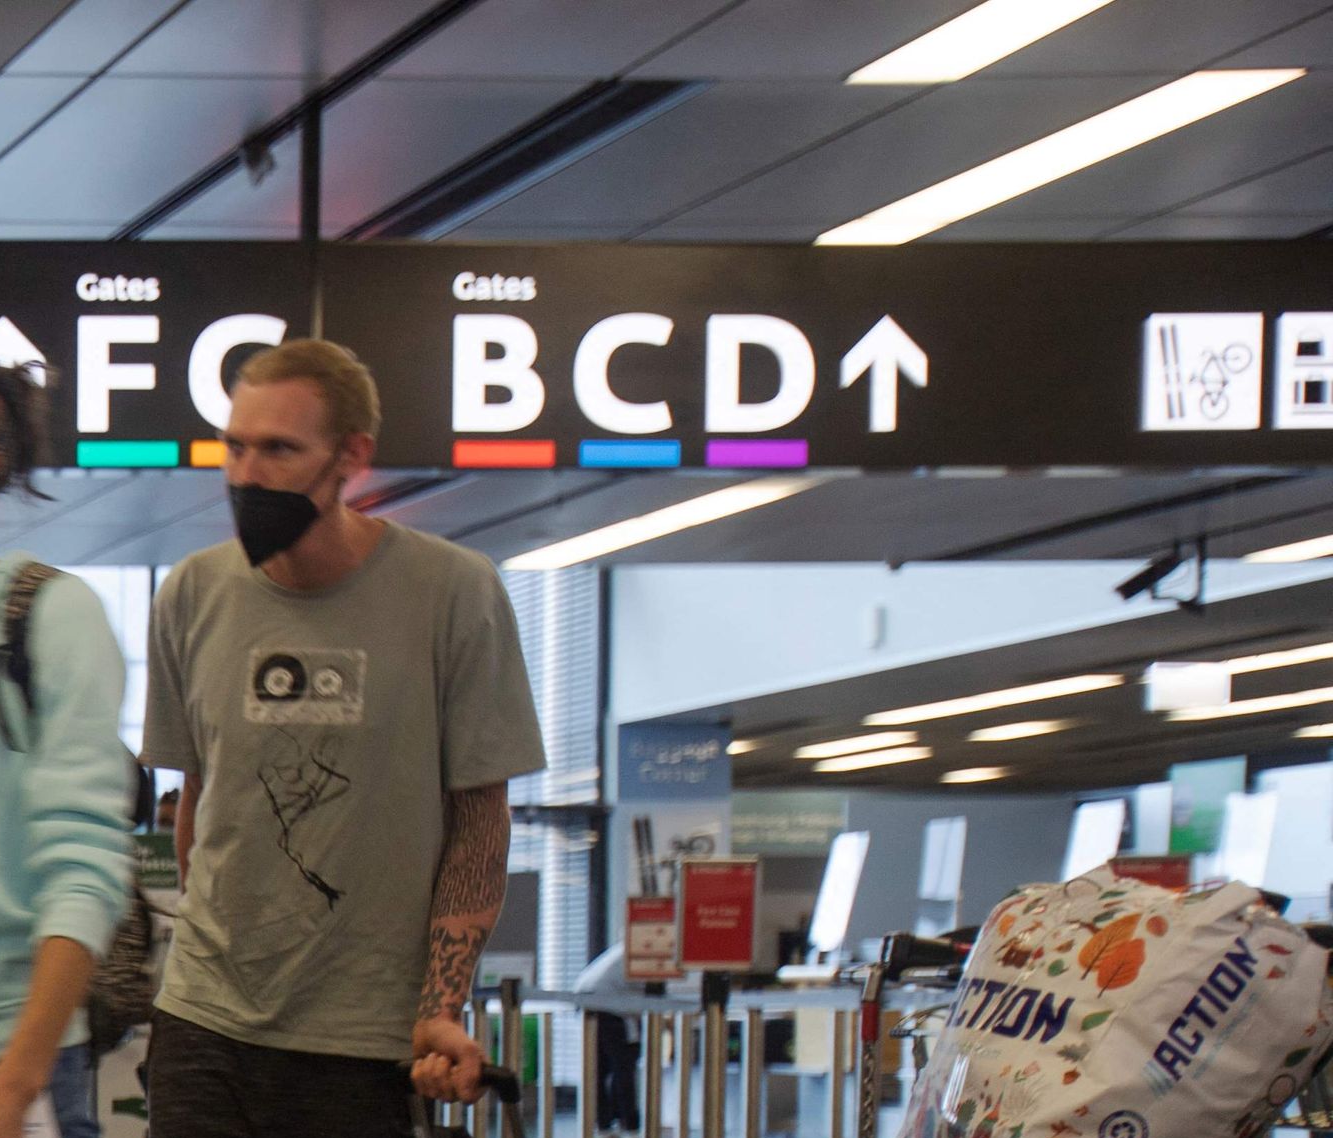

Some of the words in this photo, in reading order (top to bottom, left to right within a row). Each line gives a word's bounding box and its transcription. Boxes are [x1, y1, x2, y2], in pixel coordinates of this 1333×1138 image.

[76, 273, 160, 301] Gates
[452, 272, 537, 301] Gates
[76, 314, 160, 433] F
[451, 313, 546, 433] B
[572, 312, 674, 435] C
[704, 313, 816, 433] D
[946, 977, 1075, 1044] CTION
[1153, 937, 1258, 1082] ACTION
